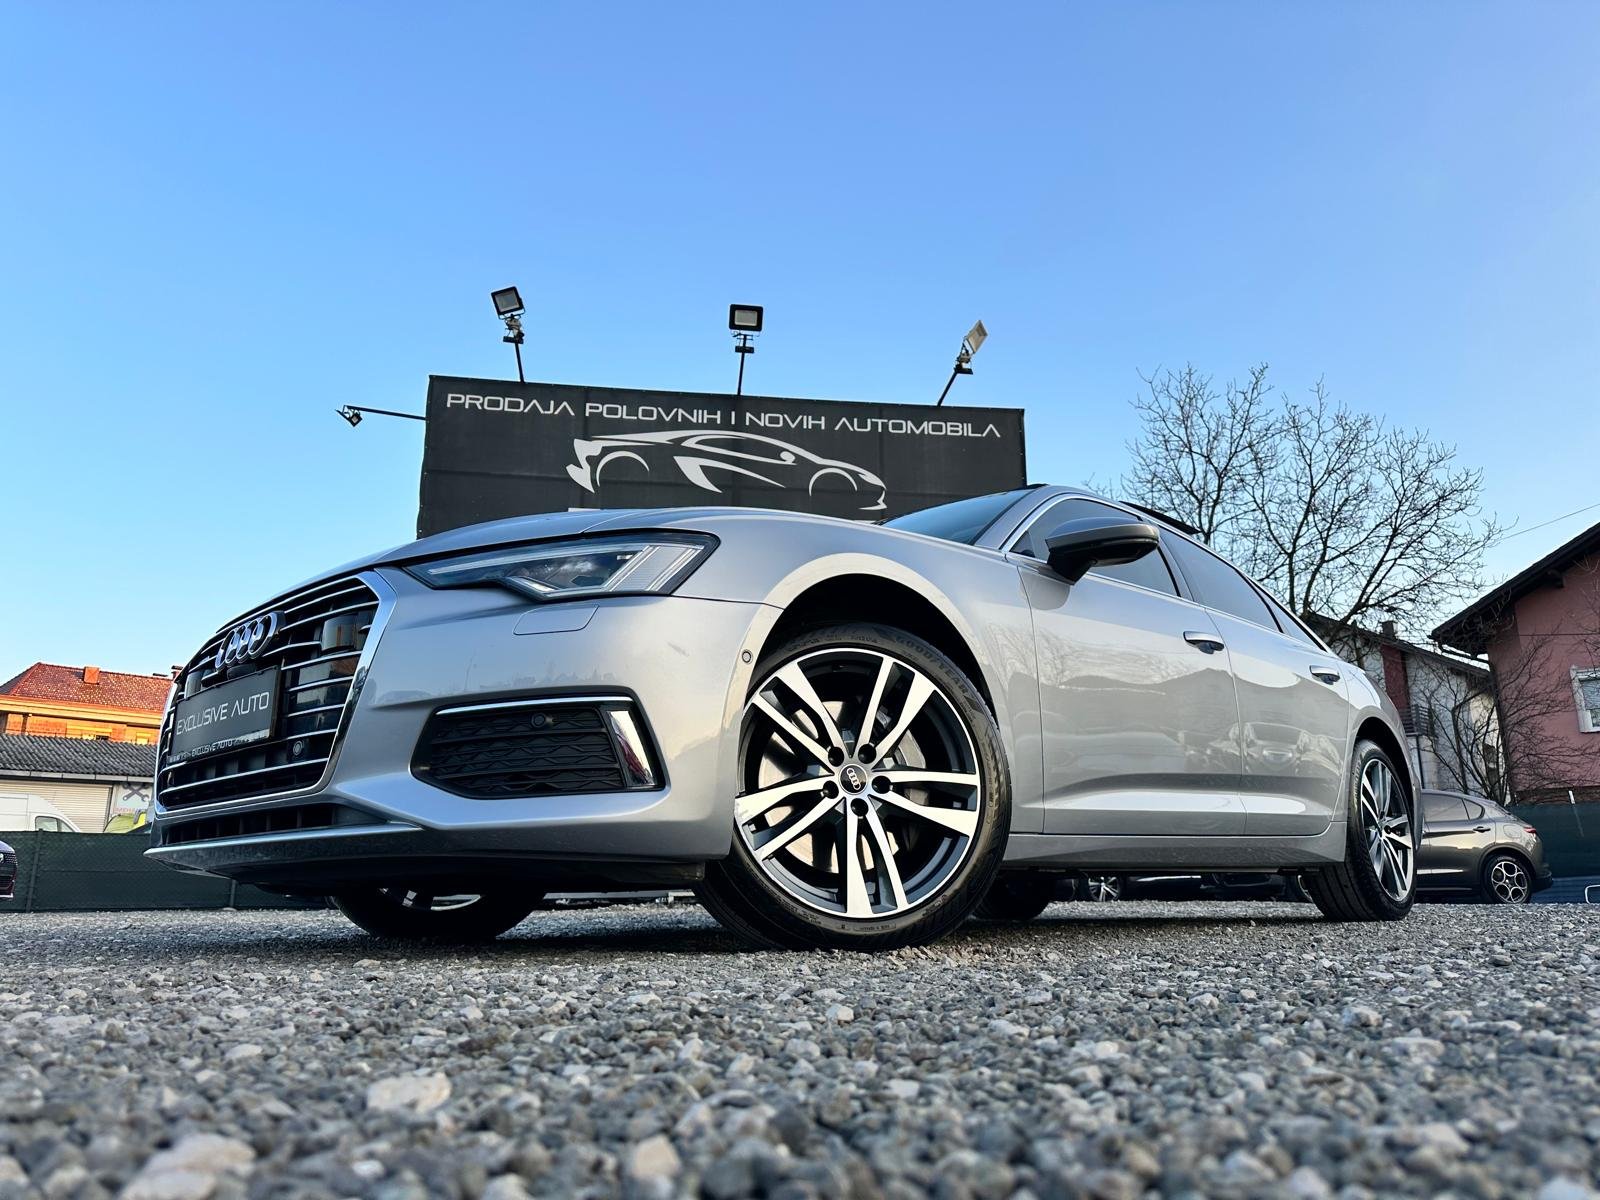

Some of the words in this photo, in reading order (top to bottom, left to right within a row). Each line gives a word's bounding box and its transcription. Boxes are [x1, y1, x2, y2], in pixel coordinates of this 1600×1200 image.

[446, 393, 575, 416] PRODAJA
[585, 402, 725, 425] POLOVNIH
[731, 411, 737, 426] I
[745, 411, 826, 430] NOVIH
[834, 417, 1001, 438] AUTOMOBILA
[176, 702, 229, 735] EXCLUSIVE
[231, 692, 269, 718] AUTO
